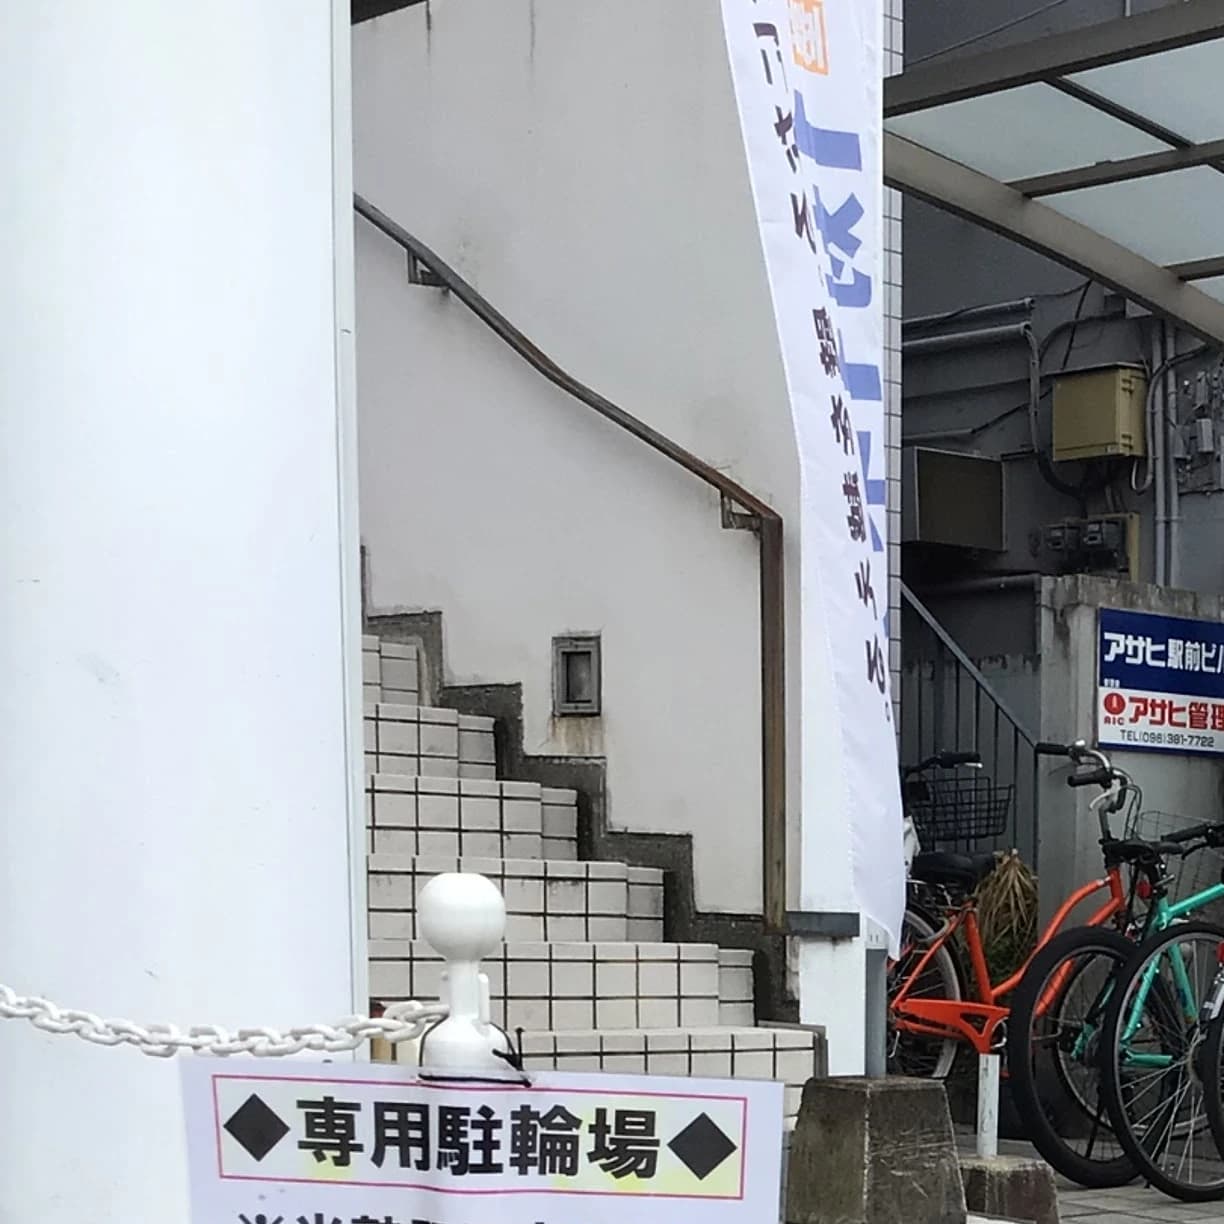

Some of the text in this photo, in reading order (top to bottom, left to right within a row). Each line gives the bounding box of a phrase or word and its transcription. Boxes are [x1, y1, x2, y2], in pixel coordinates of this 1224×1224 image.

[296, 1095, 662, 1181] 専用駐輪場
